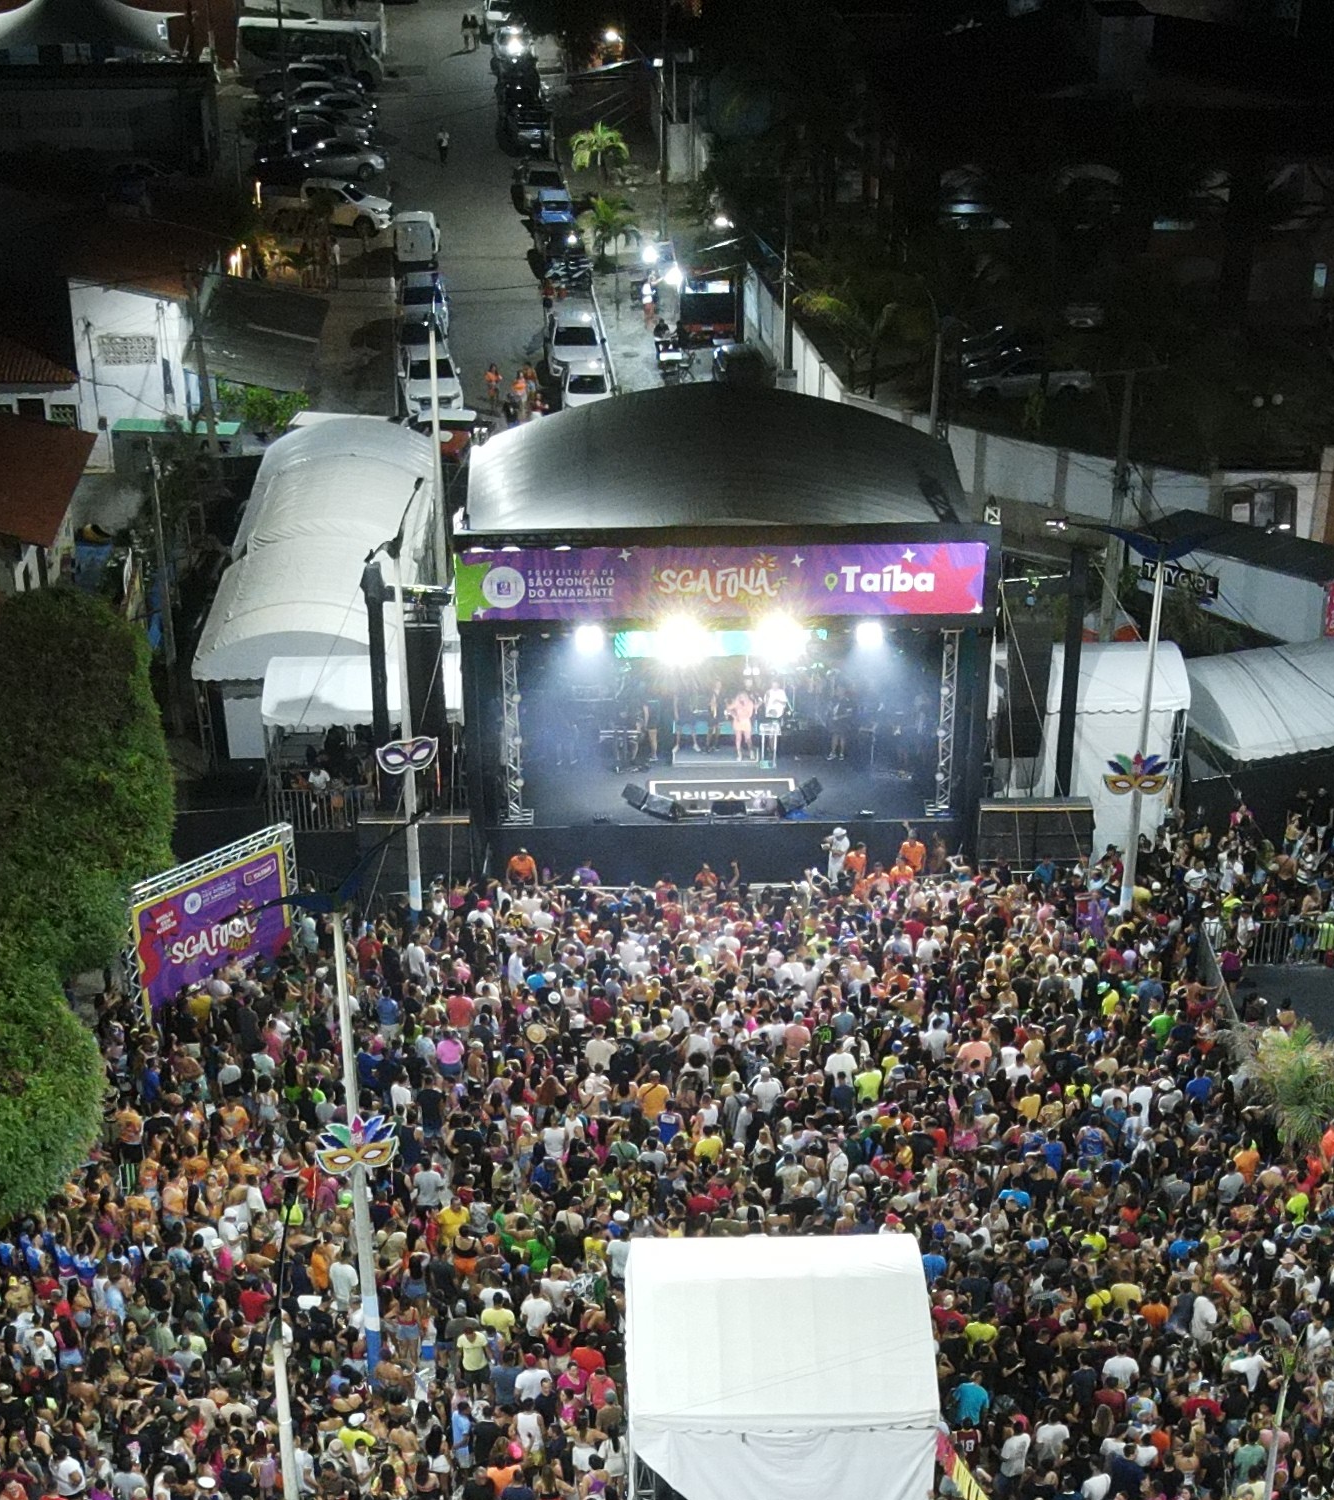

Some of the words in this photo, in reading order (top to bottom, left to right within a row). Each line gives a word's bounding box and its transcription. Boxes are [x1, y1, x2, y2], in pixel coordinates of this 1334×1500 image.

[528, 575, 553, 587] SÃO
[555, 576, 615, 589] GONÇALO
[528, 589, 546, 598] DO
[549, 588, 614, 598] AMARANTE
[659, 568, 721, 602] SGA
[717, 566, 778, 597] FOLIA
[840, 564, 935, 593] Taíba
[1145, 562, 1213, 594] TTYGIRL
[171, 930, 218, 964] SGA
